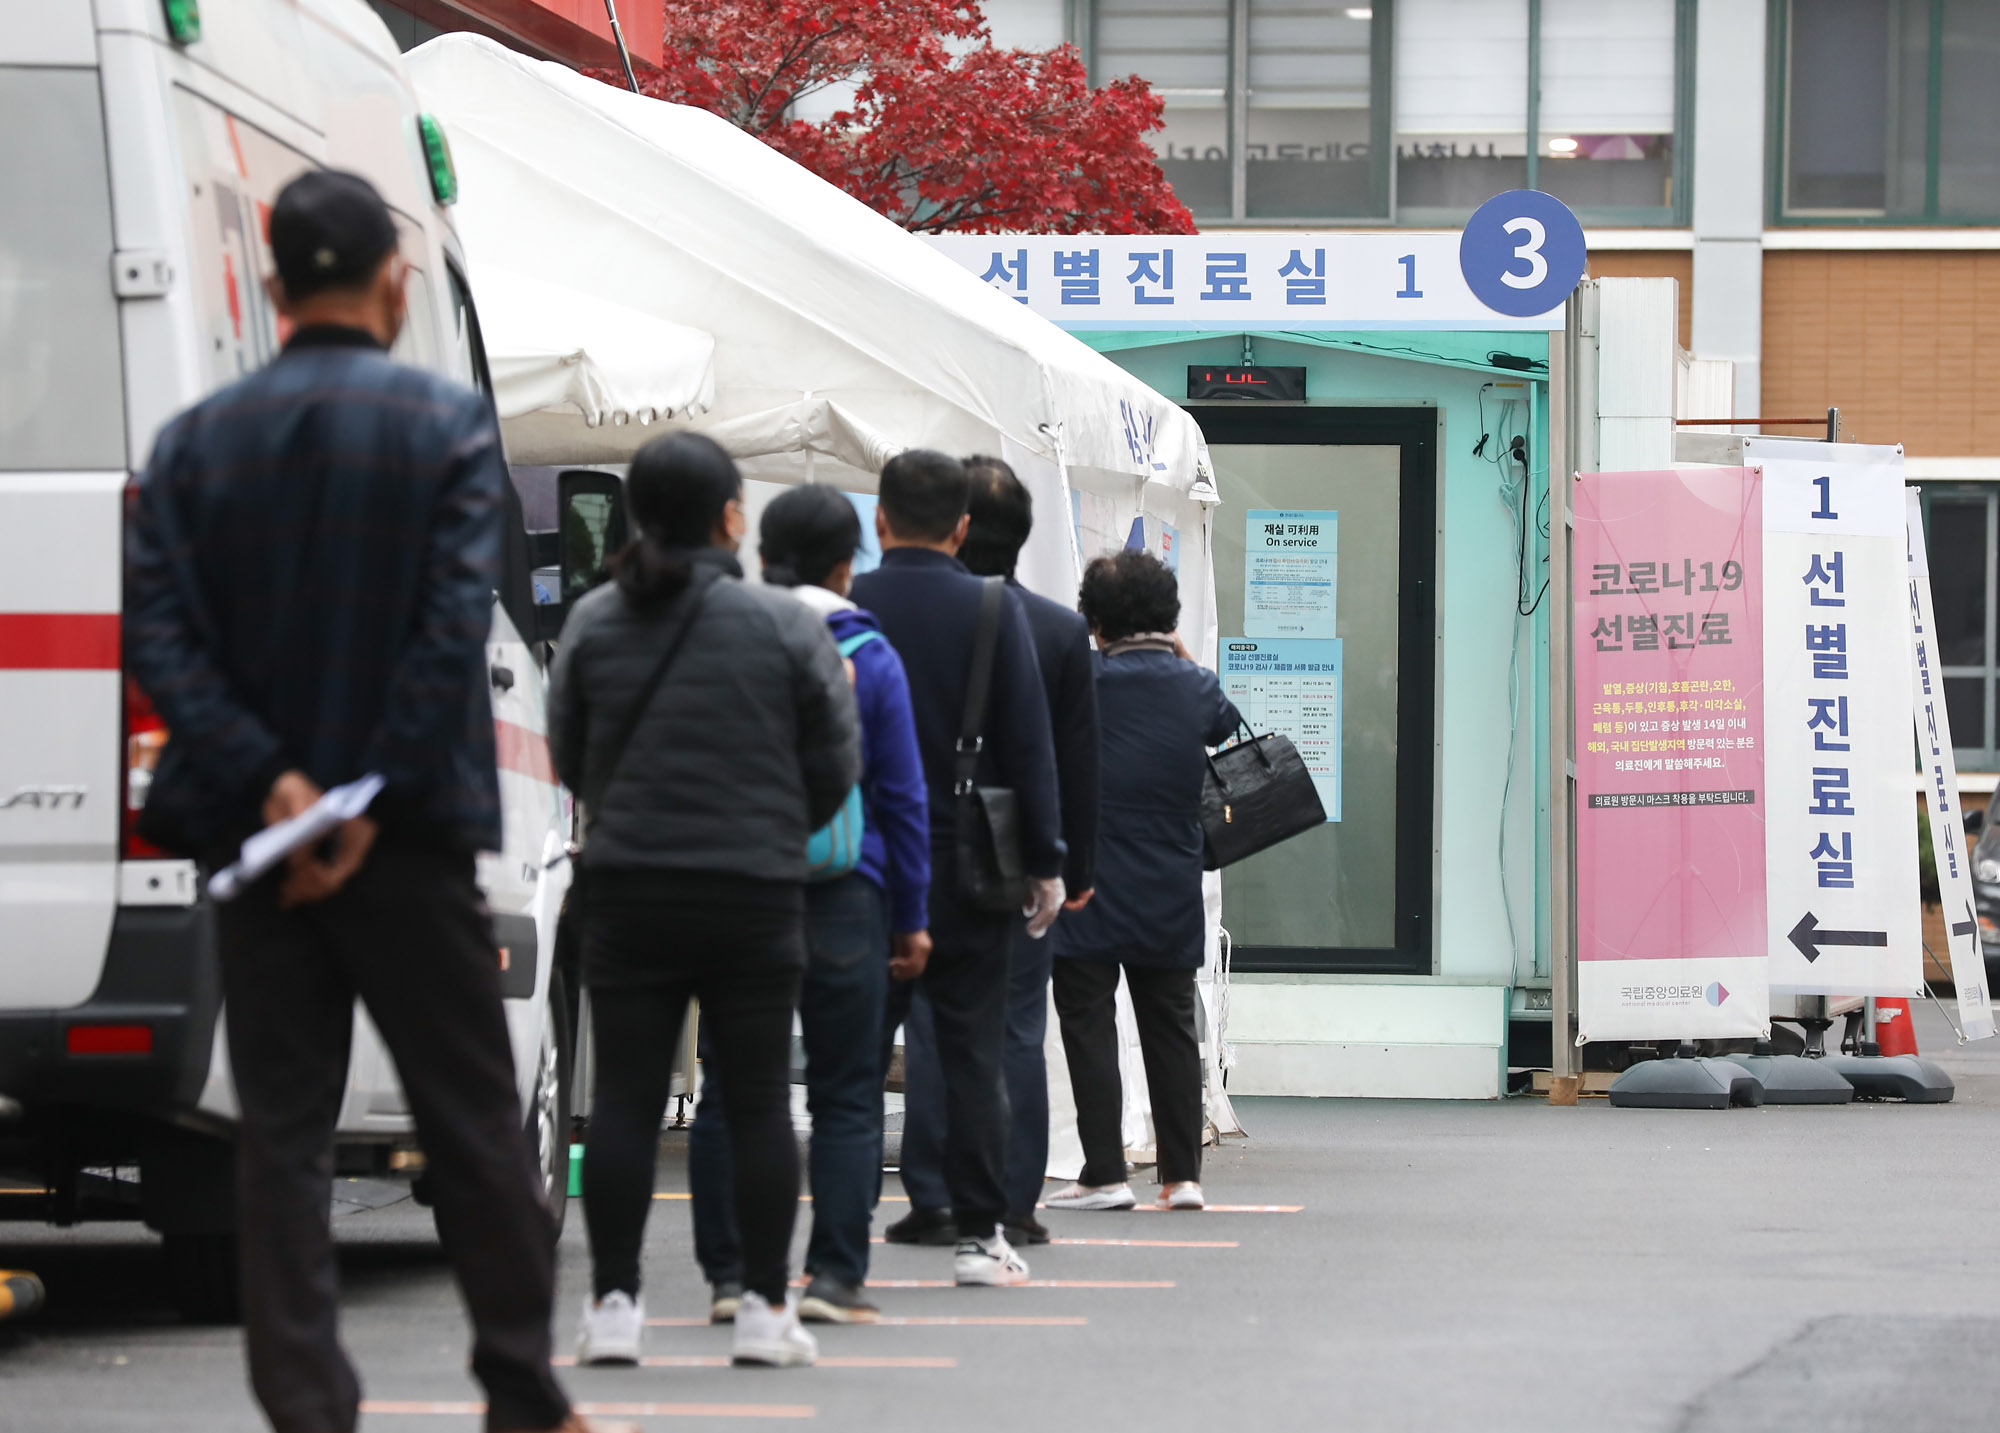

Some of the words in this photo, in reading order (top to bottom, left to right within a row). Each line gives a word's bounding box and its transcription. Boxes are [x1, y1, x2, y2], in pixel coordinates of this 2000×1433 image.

[1500, 217, 1548, 289] 3
[981, 248, 1327, 305] 선별진료실
[1396, 254, 1424, 298] 1
[1811, 476, 1838, 520] 1
[1265, 524, 1284, 535] 재실
[1288, 524, 1319, 536] 可利用
[1266, 537, 1280, 547] On
[1283, 537, 1318, 547] service
[1590, 558, 1742, 595] 코로나19
[1590, 612, 1732, 651] 선별진료
[1228, 663, 1253, 671] 코로나19
[1255, 663, 1268, 671] 검사
[1640, 720, 1659, 732] 있고
[1661, 720, 1680, 732] 증상
[1682, 720, 1700, 731] 발생
[1704, 718, 1724, 730] 14일
[1727, 717, 1746, 730] 이내
[1802, 551, 1855, 888] 선별진료실
[1908, 578, 1958, 879] 선별진료실
[1611, 740, 1629, 752] 국내
[1631, 739, 1686, 752] 집단발생지역
[1716, 737, 1735, 749] 있는
[1736, 737, 1755, 749] 분은
[1615, 759, 1662, 772] 의료진에게
[1665, 757, 1725, 771] 말씀해주세요.
[1595, 794, 1619, 807] 의료원
[1620, 794, 1645, 806] 방문시
[1646, 793, 1671, 805] 마스크
[1672, 793, 1696, 805] 착용을
[1698, 791, 1749, 804] 부탁드립니다.
[1621, 985, 1703, 1000] 국립중앙의료원
